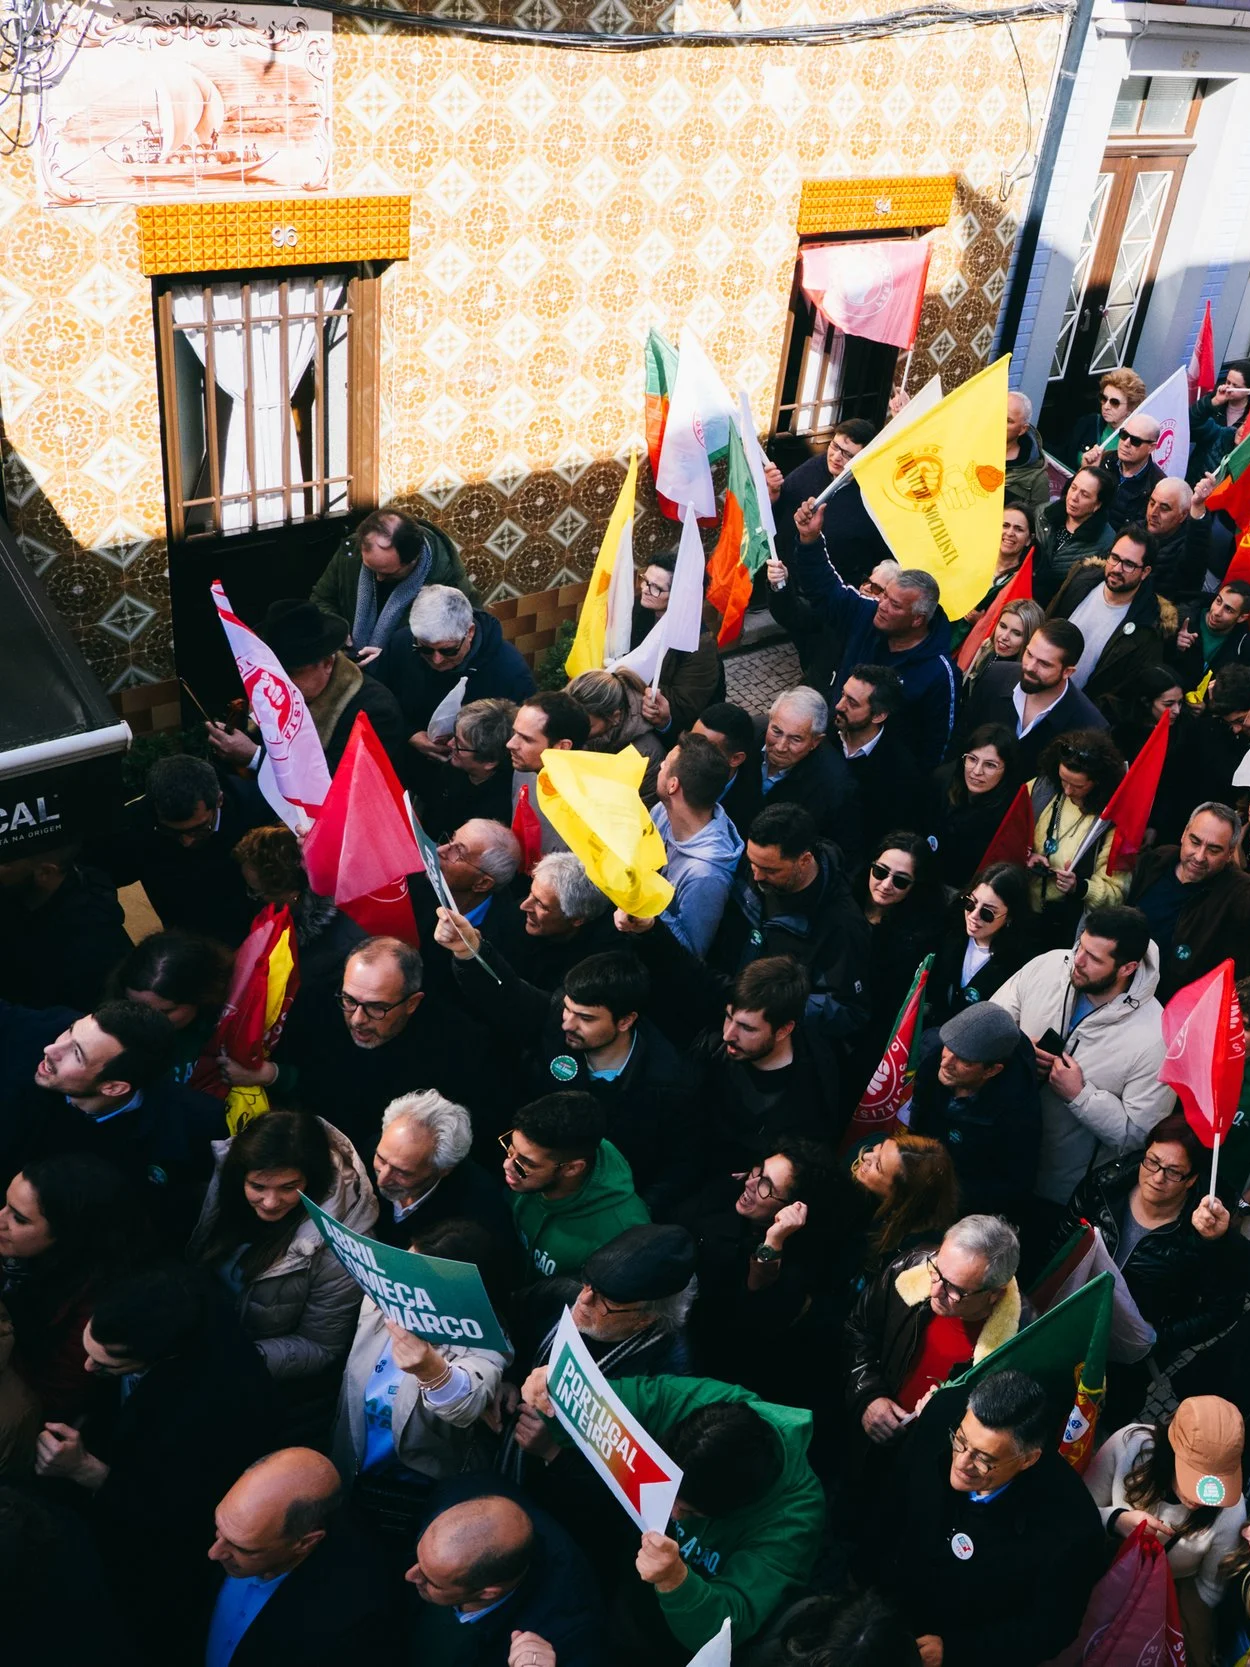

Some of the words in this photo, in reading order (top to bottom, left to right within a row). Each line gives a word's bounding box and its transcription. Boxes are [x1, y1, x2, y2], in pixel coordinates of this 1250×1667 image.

[271, 226, 299, 248] 96
[12, 834, 25, 843] NA
[28, 824, 62, 839] ORIGEM
[321, 1215, 387, 1275] ABRIL
[332, 1241, 437, 1313] COMEÇA
[555, 1375, 613, 1461] INTEIRO
[563, 1357, 638, 1474] PORTUGAL
